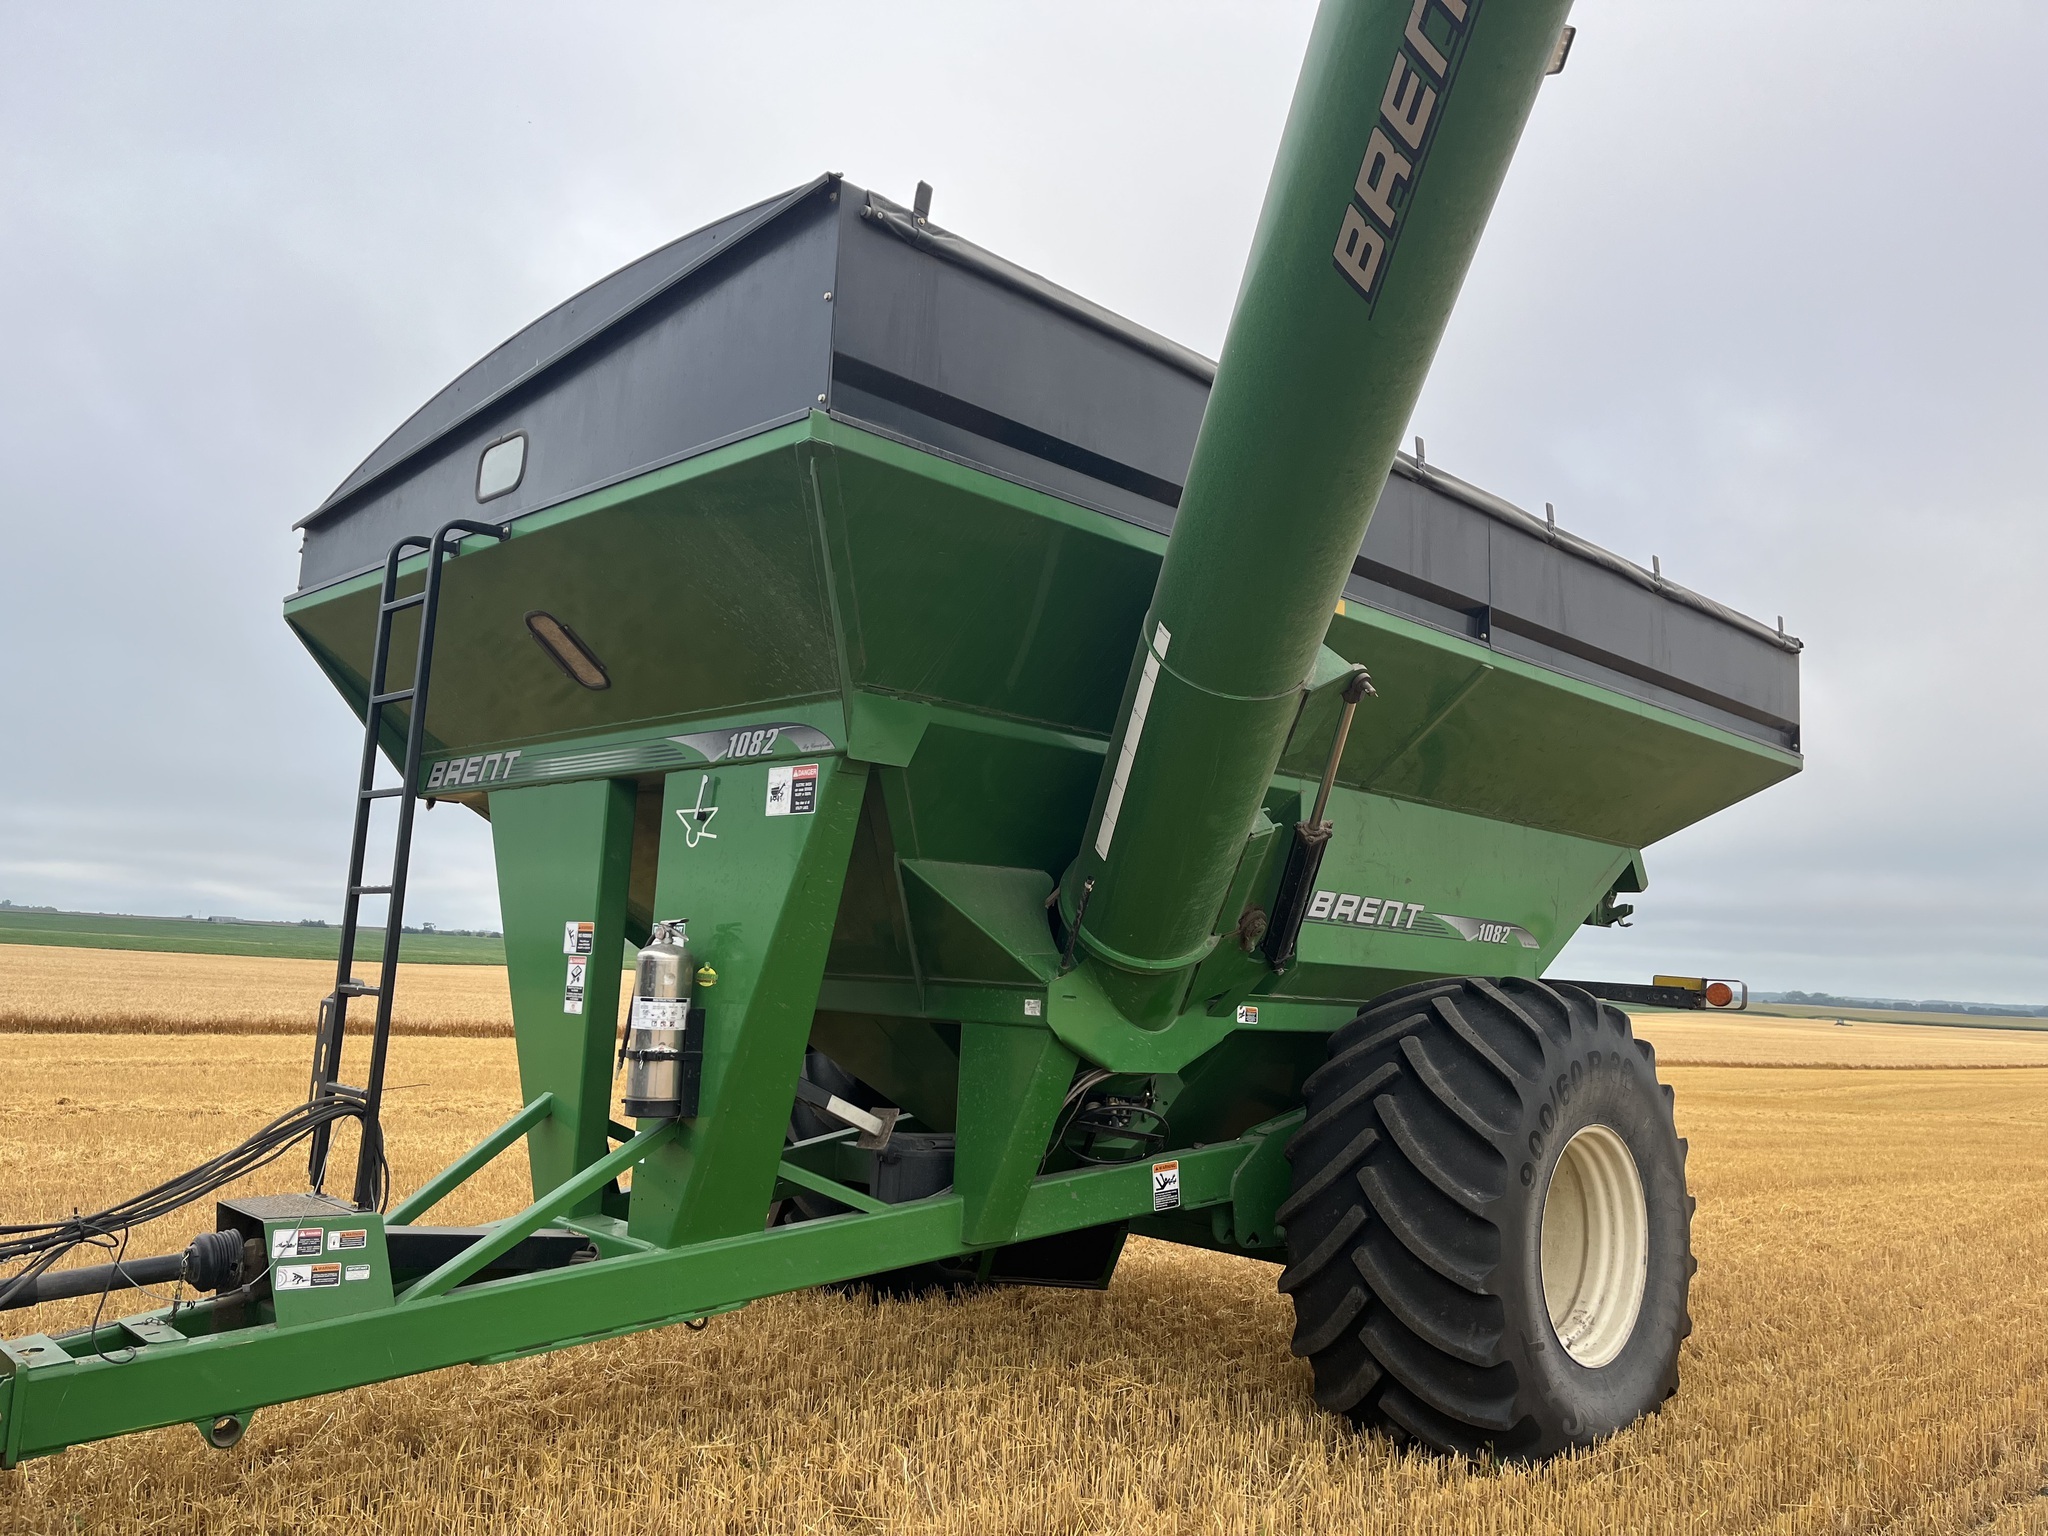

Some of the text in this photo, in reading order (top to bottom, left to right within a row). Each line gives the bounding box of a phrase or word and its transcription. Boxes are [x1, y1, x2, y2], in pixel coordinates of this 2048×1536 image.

[726, 728, 780, 759] 1082
[425, 749, 522, 789] BRENT
[1306, 890, 1426, 929] BRENT
[1476, 923, 1512, 944] 1082
